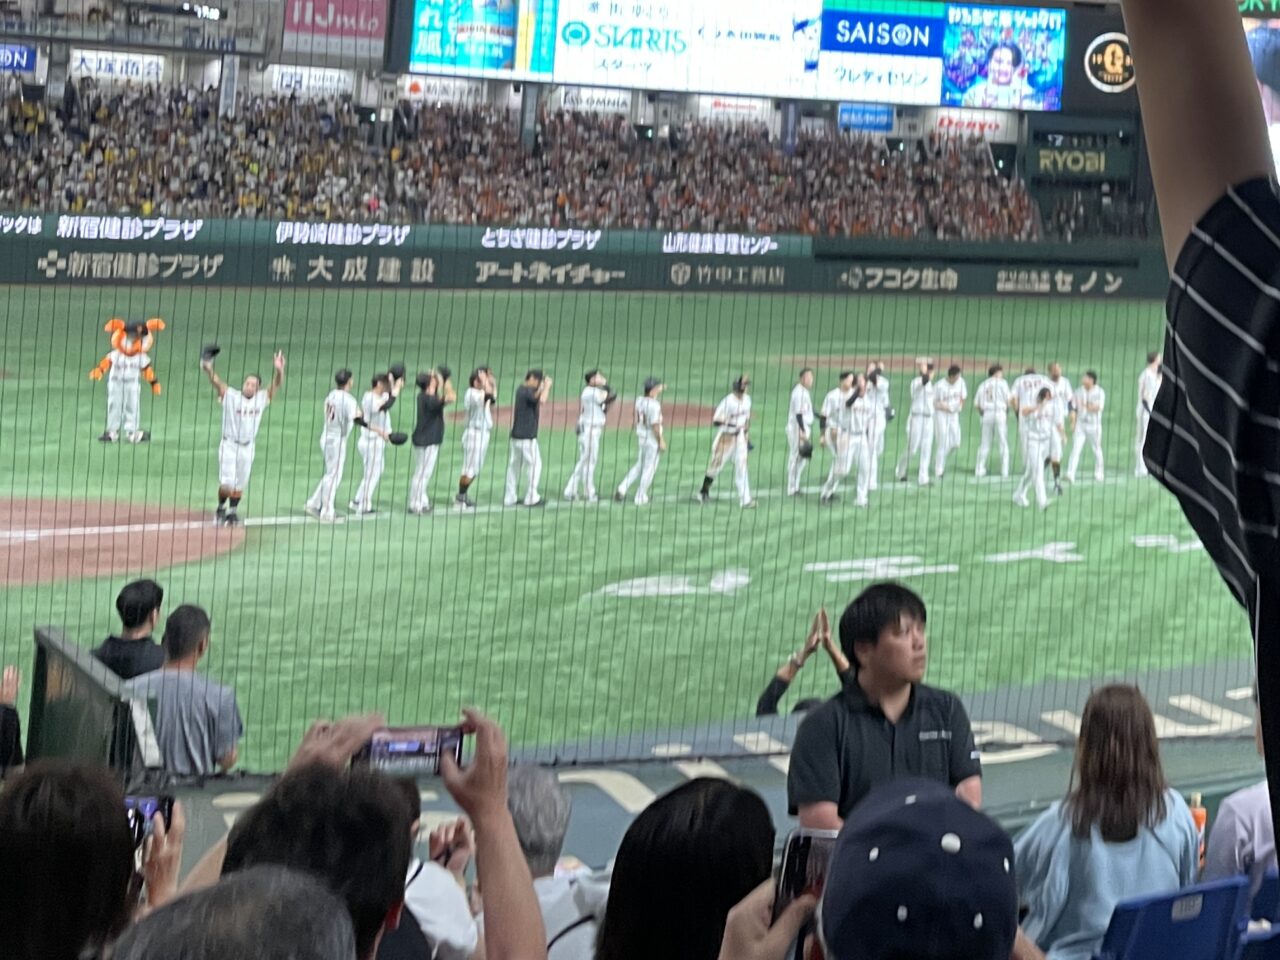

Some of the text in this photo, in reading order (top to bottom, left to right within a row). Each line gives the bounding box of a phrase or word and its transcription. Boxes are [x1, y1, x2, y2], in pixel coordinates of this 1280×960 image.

[836, 19, 930, 48] SAISON
[1039, 149, 1107, 174] RYOBI
[0, 214, 42, 235] ックは
[56, 214, 203, 241] 新宿健診プラザ
[66, 250, 224, 280] 新宿健診プラザ
[306, 254, 435, 284] 大成建設
[475, 261, 626, 285] アートネイチャー
[865, 266, 958, 290] フコク生命
